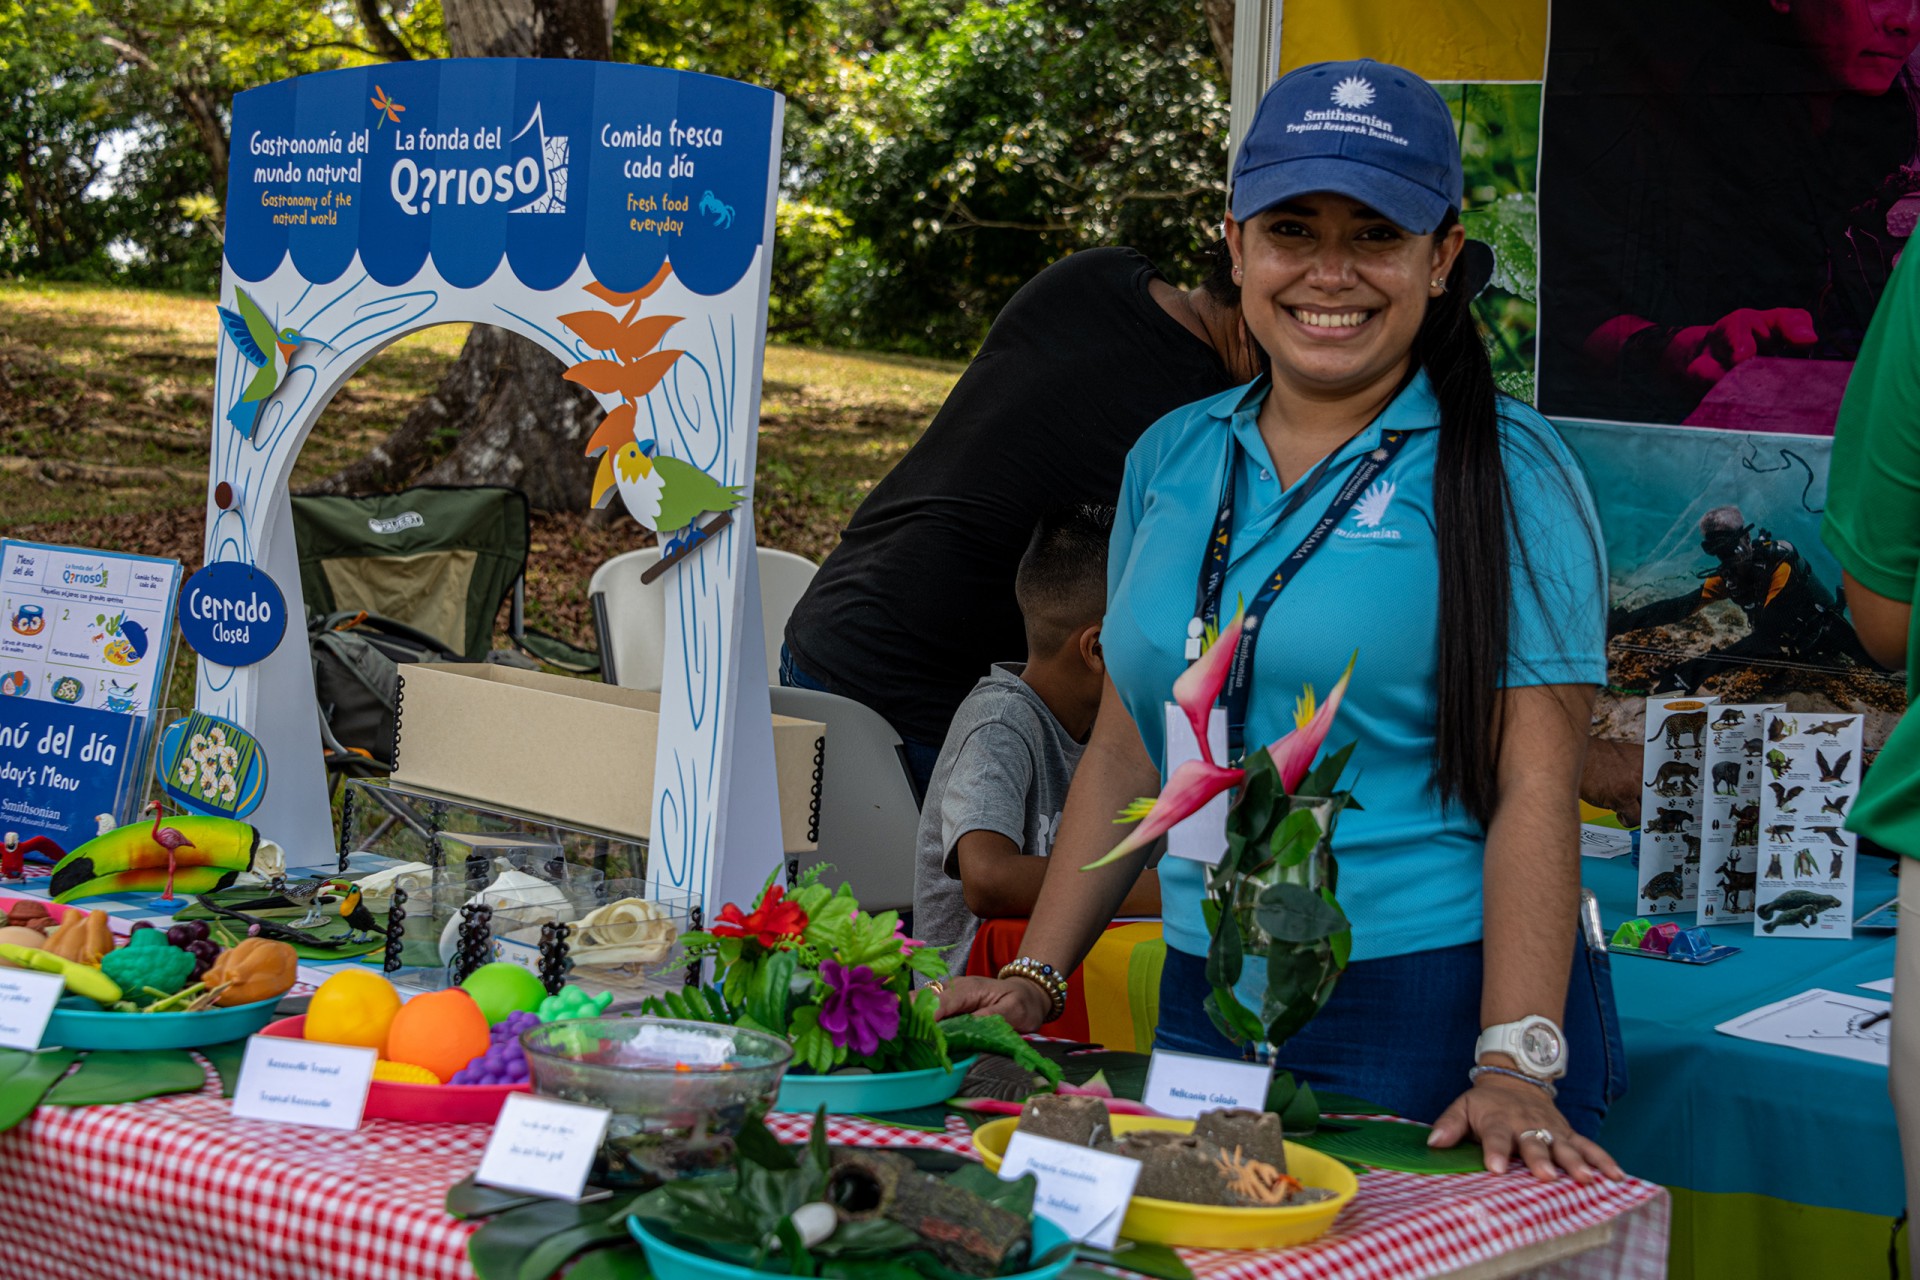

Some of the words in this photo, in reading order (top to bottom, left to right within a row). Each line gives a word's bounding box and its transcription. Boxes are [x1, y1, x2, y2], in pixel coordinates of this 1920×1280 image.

[1304, 108, 1392, 132] Smithsonian
[250, 130, 342, 156] Gastronomía
[348, 128, 369, 154] del
[395, 130, 414, 150] La
[419, 127, 469, 150] fonda
[474, 126, 502, 150] del
[601, 123, 662, 148] Comida
[670, 119, 722, 148] fresca
[1286, 122, 1322, 134] Tropical
[1323, 123, 1366, 135] Research
[1368, 126, 1408, 146] Institute
[254, 161, 302, 183] mundo
[307, 158, 362, 185] natural
[624, 155, 662, 178] cada
[668, 153, 694, 178] día
[261, 190, 318, 210] Gastronomy
[321, 190, 332, 206] of
[336, 192, 352, 208] the
[626, 192, 657, 212] Fresh
[662, 193, 688, 212] food
[273, 209, 307, 226] natural
[310, 209, 337, 225] world
[630, 216, 684, 236] everyday
[1292, 518, 1334, 560] PANAMA
[190, 588, 271, 622] Cerrado
[212, 622, 250, 644] Closed
[1236, 634, 1252, 688] Smithsonian
[0, 722, 30, 748] nú
[37, 725, 74, 759] del
[80, 732, 117, 766] día
[0, 761, 36, 788] day's
[40, 765, 80, 792] Menu
[1, 798, 60, 820] Smithsonian
